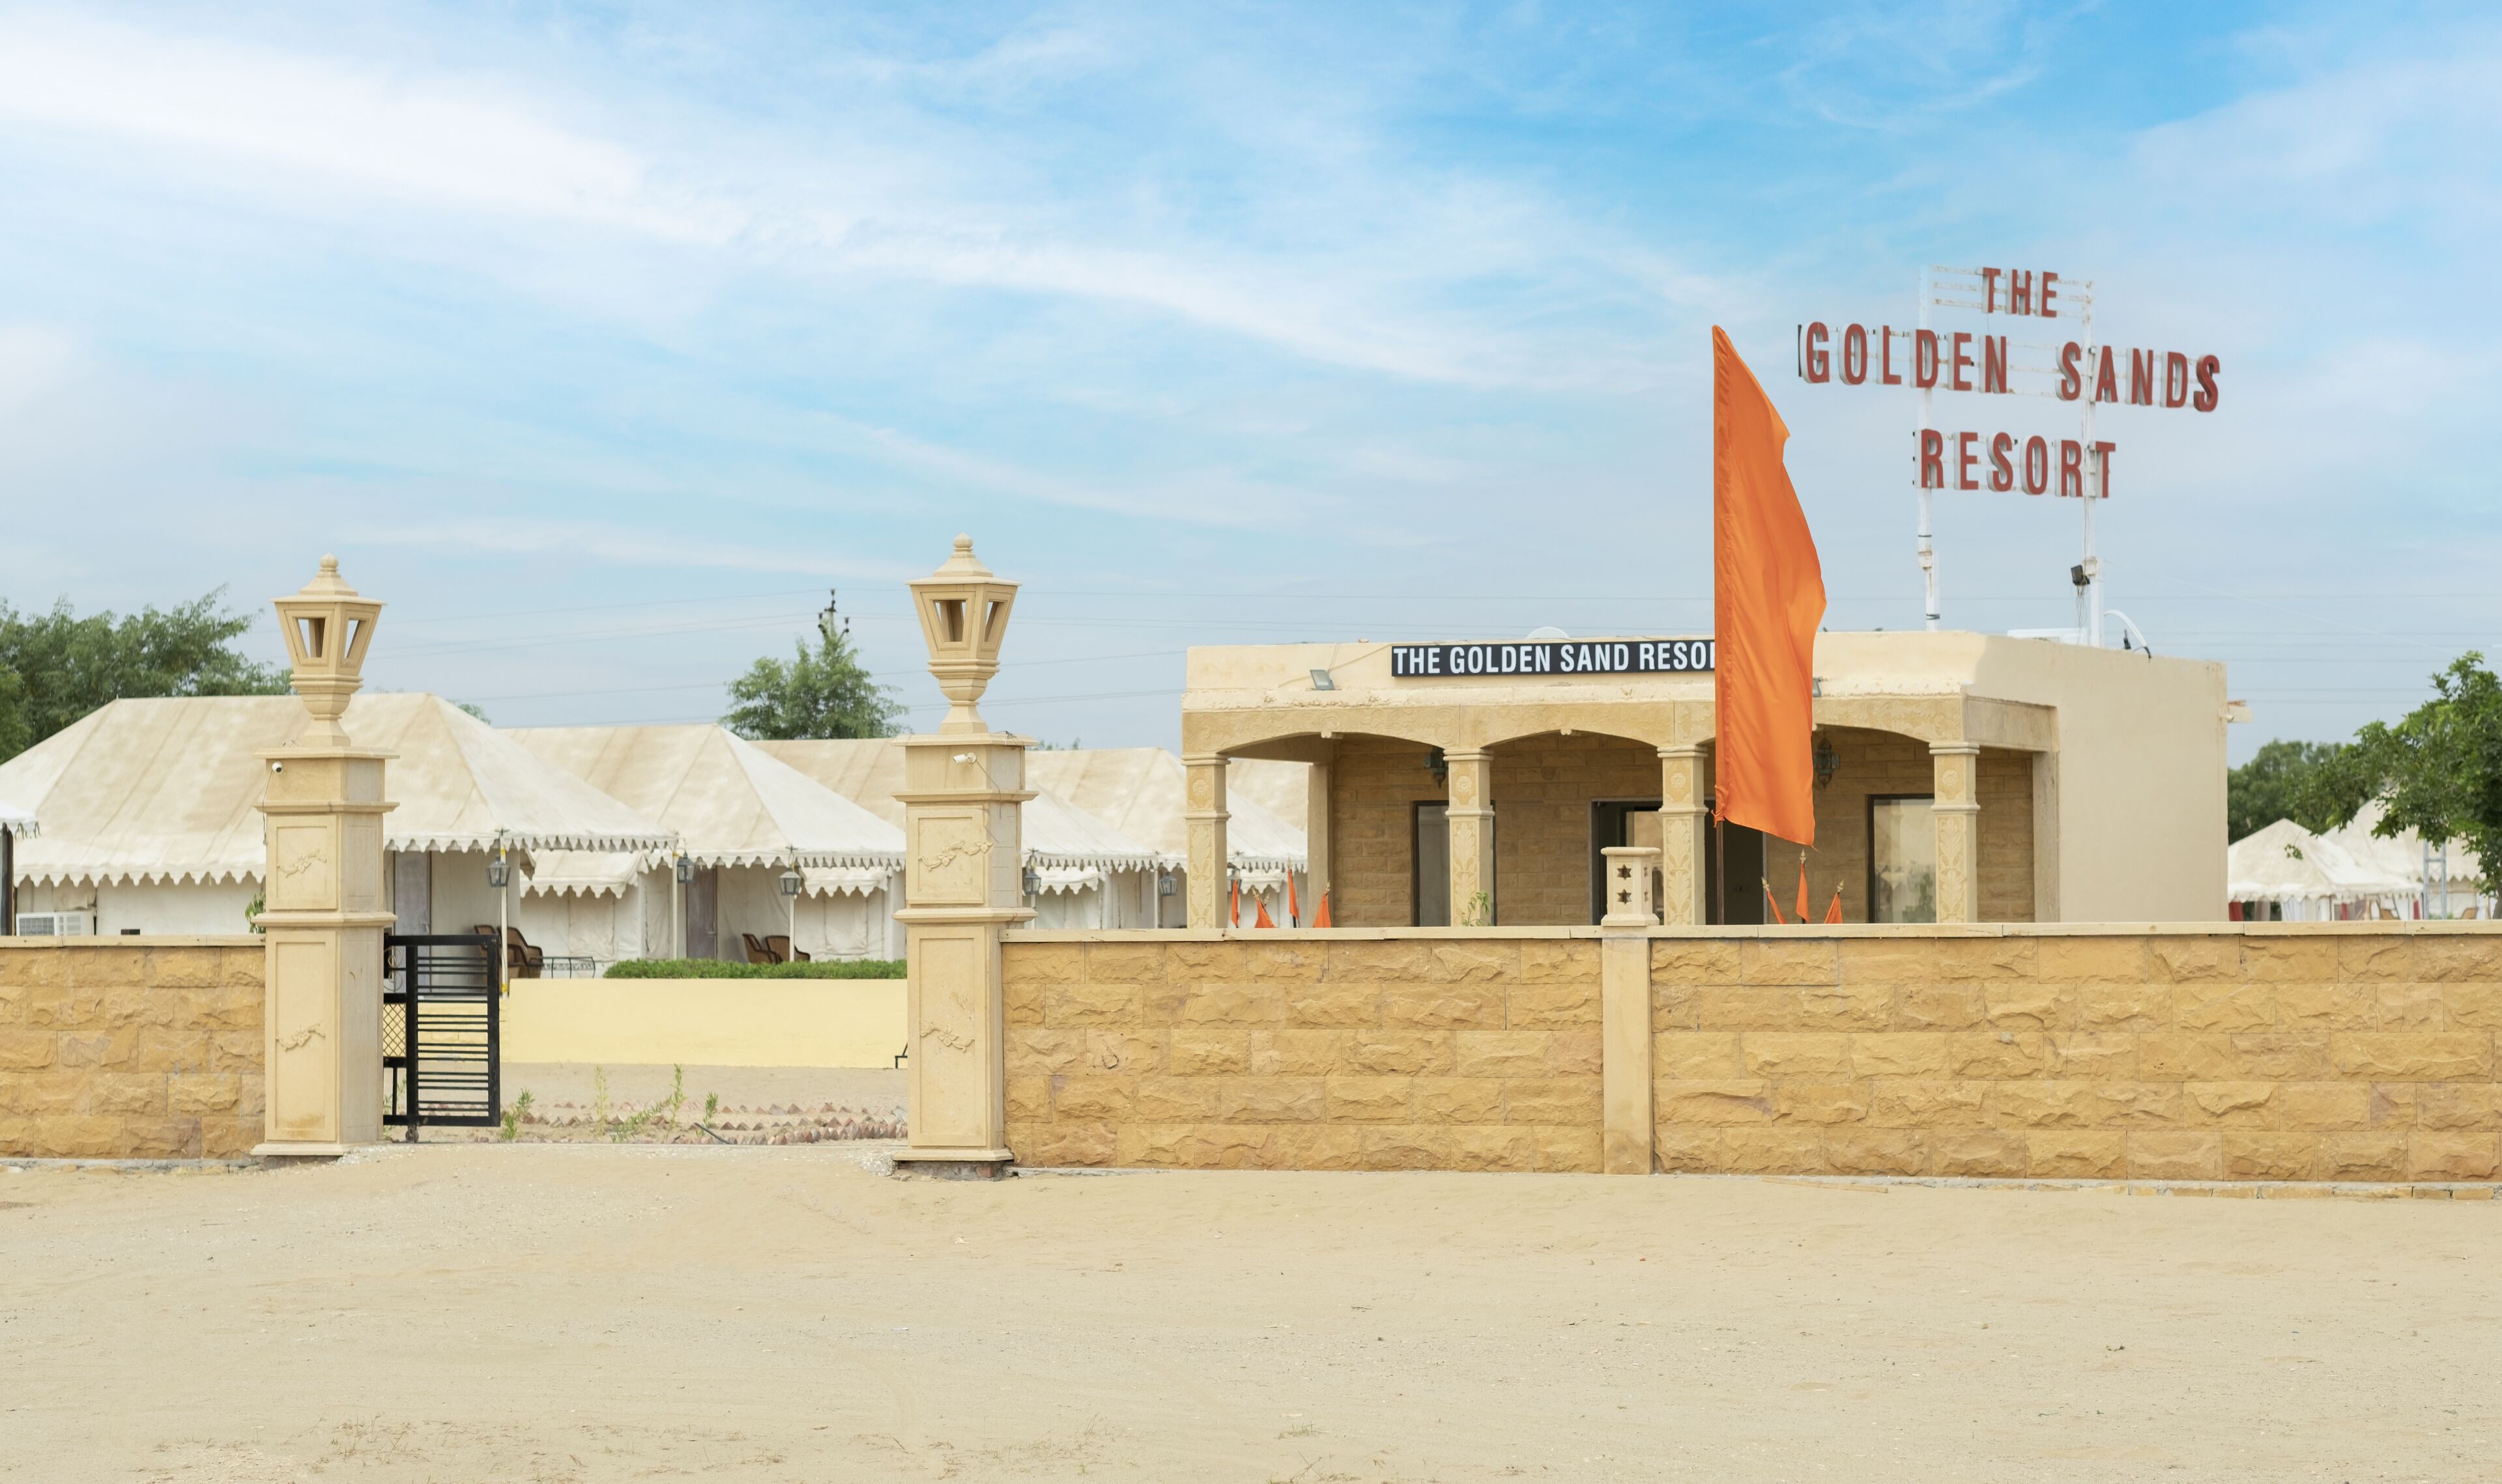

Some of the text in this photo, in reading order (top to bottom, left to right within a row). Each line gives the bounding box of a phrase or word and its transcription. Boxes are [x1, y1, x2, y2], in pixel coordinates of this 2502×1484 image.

[1983, 266, 2058, 318] THE
[1802, 321, 2221, 412] GOLDEN SANDS
[1918, 429, 2116, 498] RESORT
[1393, 648, 1441, 674] THE
[1449, 645, 1550, 674] GOLDEN
[1560, 644, 1629, 672] SAND
